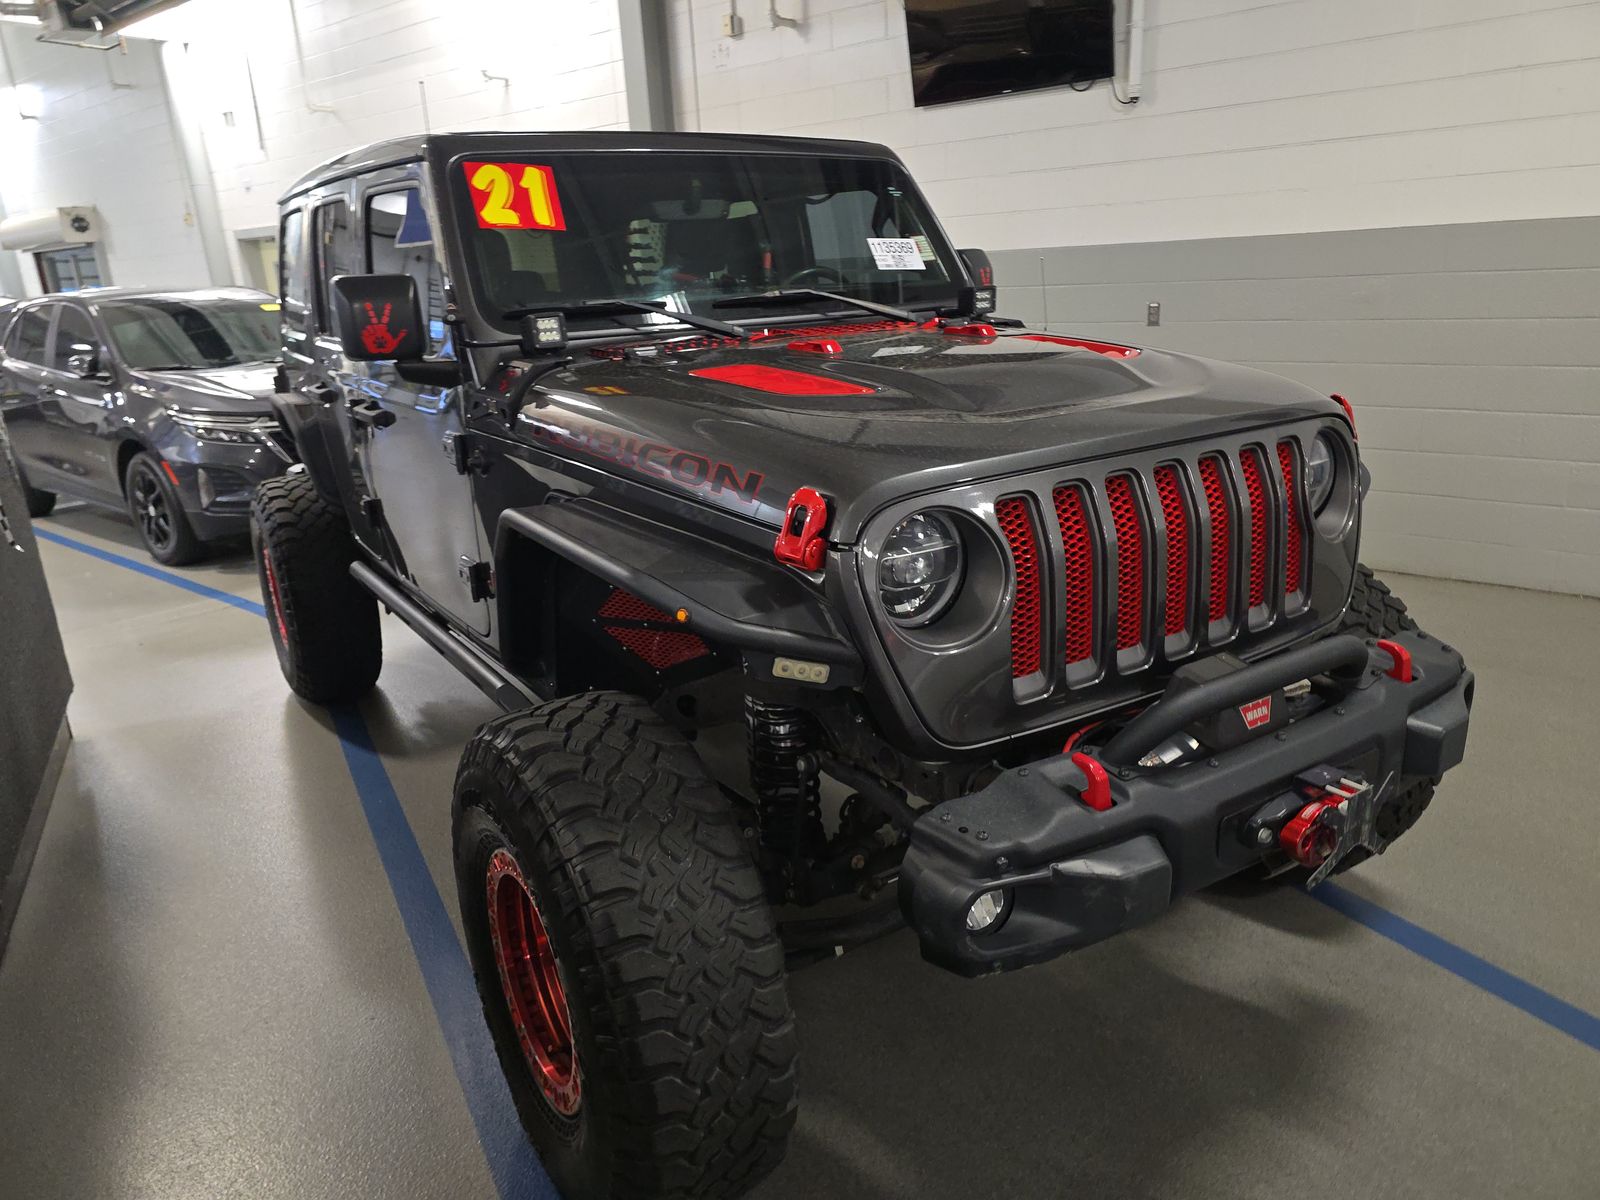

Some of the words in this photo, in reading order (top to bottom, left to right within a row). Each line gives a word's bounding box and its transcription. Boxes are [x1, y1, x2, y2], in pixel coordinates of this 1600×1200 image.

[471, 164, 555, 227] 21
[871, 241, 915, 254] 1135369
[1246, 705, 1268, 722] WARN
